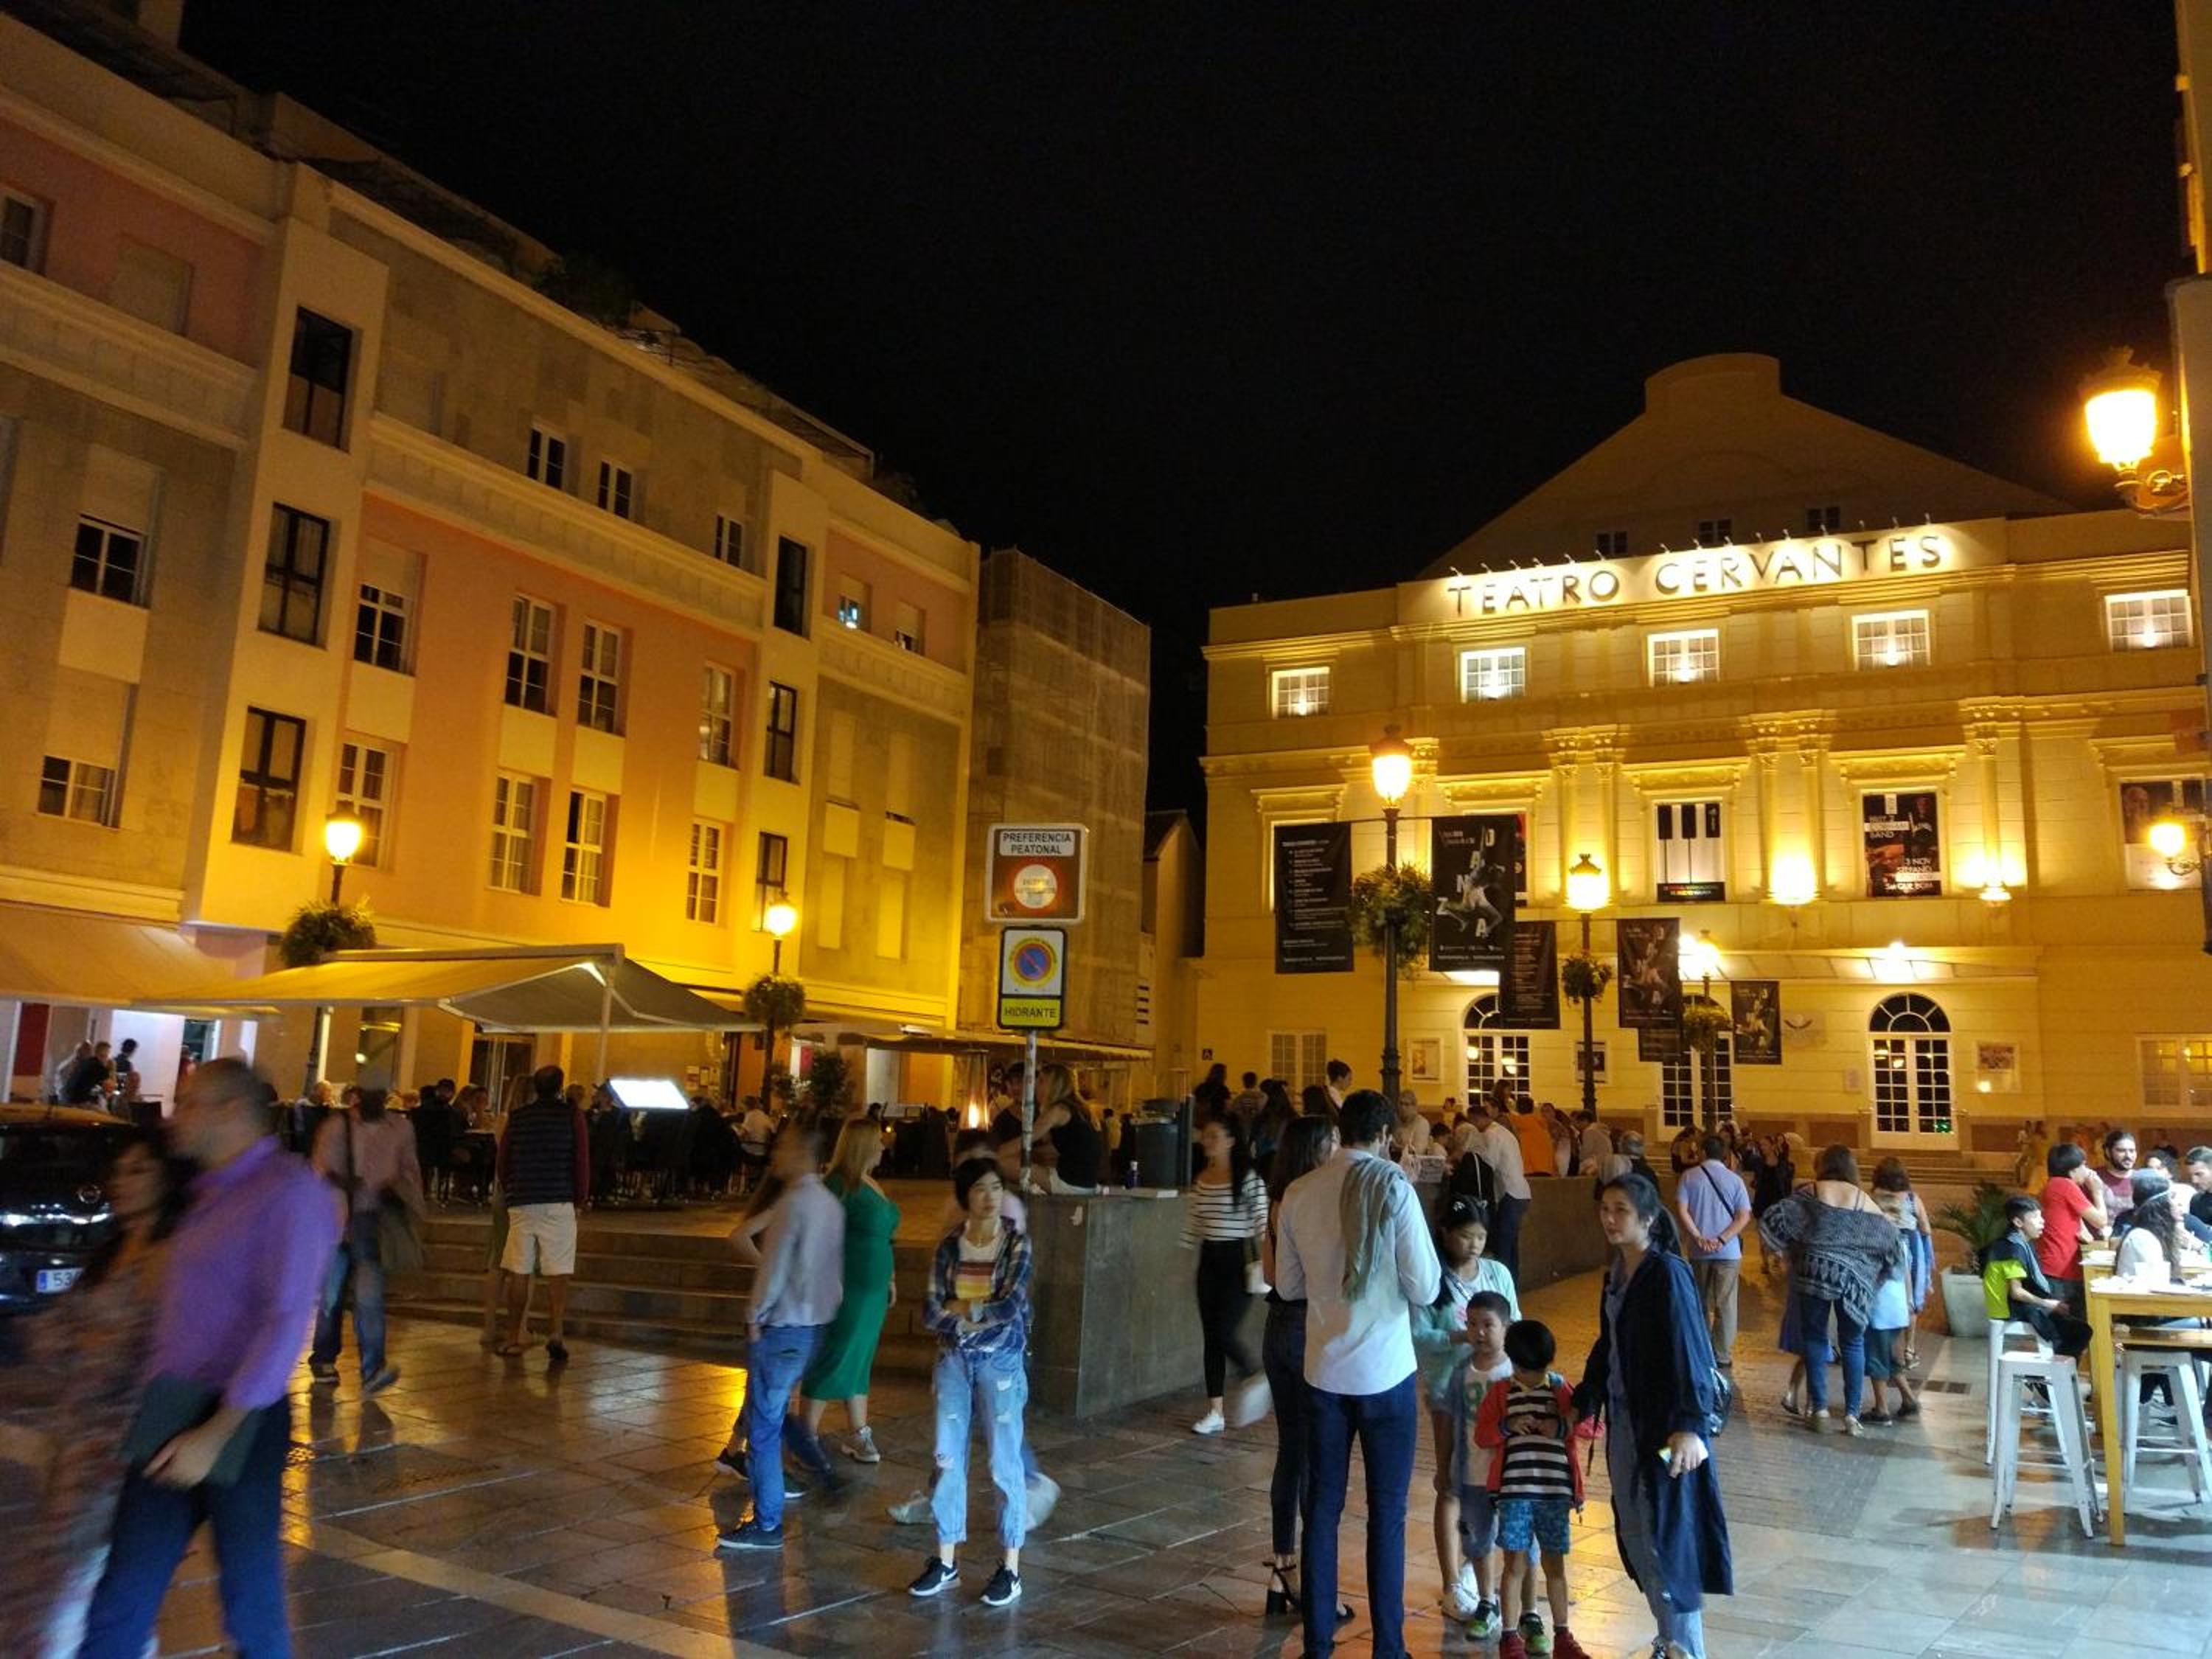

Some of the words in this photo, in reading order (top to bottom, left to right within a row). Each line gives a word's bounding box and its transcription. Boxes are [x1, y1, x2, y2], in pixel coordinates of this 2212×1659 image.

[1447, 571, 1620, 617] TEATRO
[1655, 535, 1941, 594] CERVANTES
[1002, 832, 1071, 842] PREFERENCIA
[1011, 844, 1062, 855] PEATONAL
[1004, 1006, 1056, 1018] HIDRANTE
